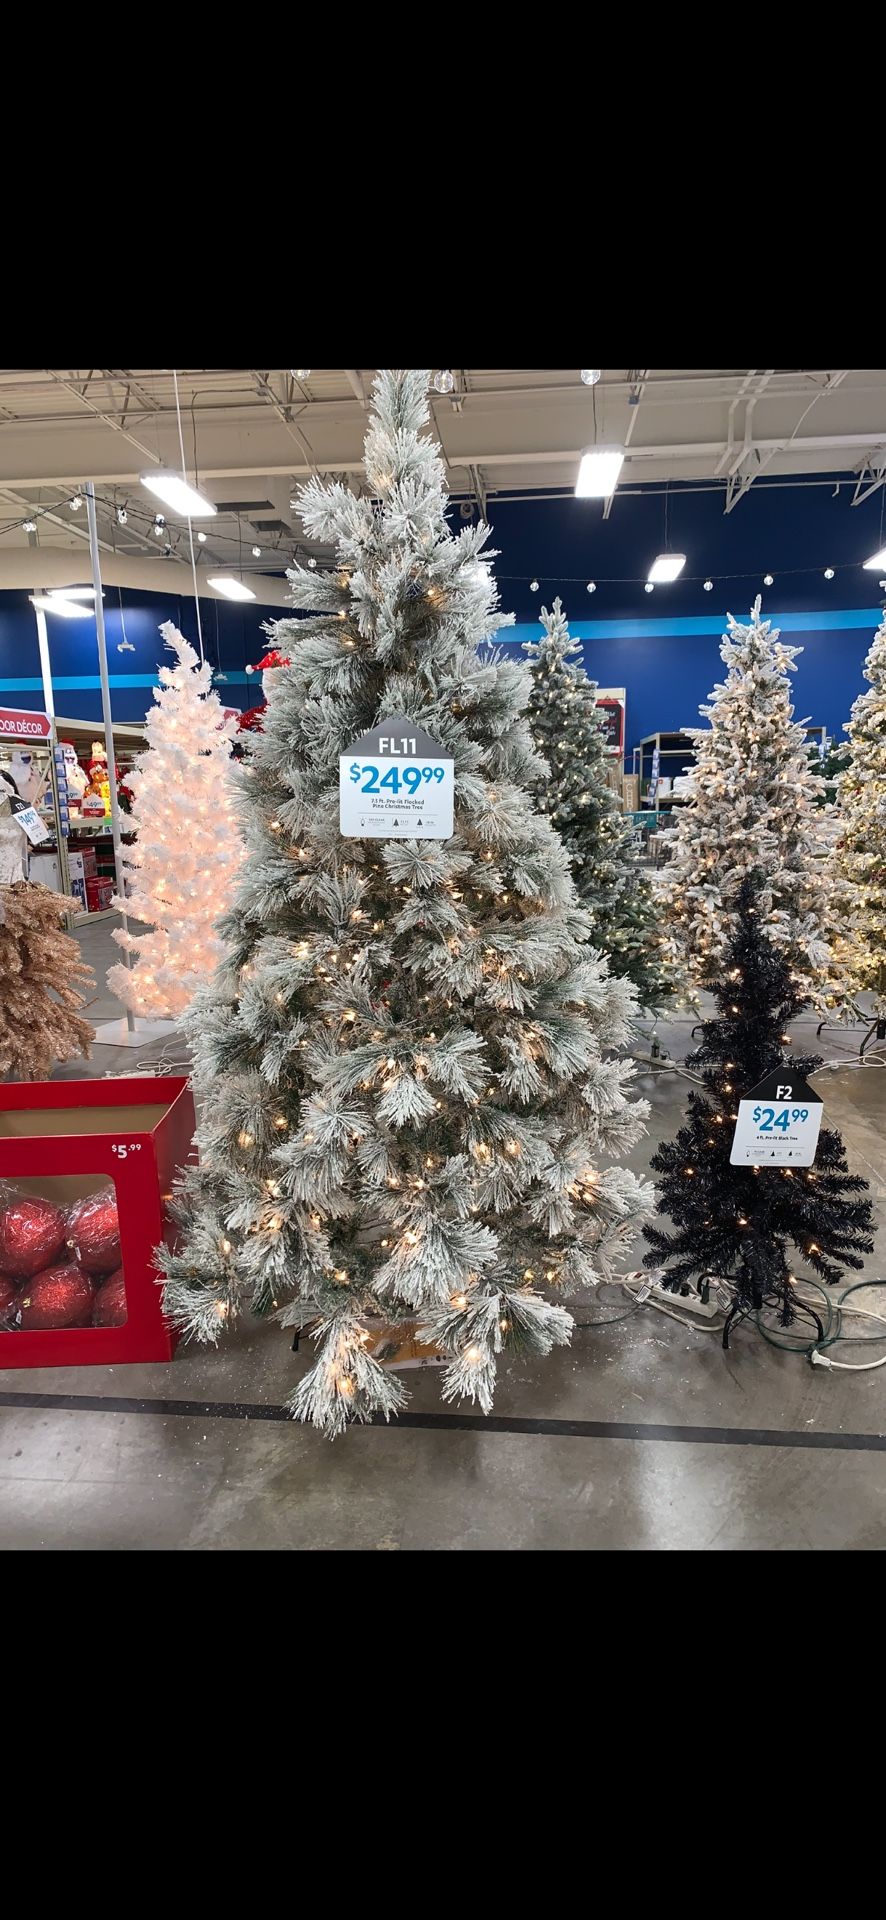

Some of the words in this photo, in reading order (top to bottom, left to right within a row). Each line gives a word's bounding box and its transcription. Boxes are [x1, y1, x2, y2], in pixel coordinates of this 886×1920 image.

[17, 719, 43, 735] DÉCOR
[378, 737, 417, 754] FL11
[776, 1085, 793, 1100] F2
